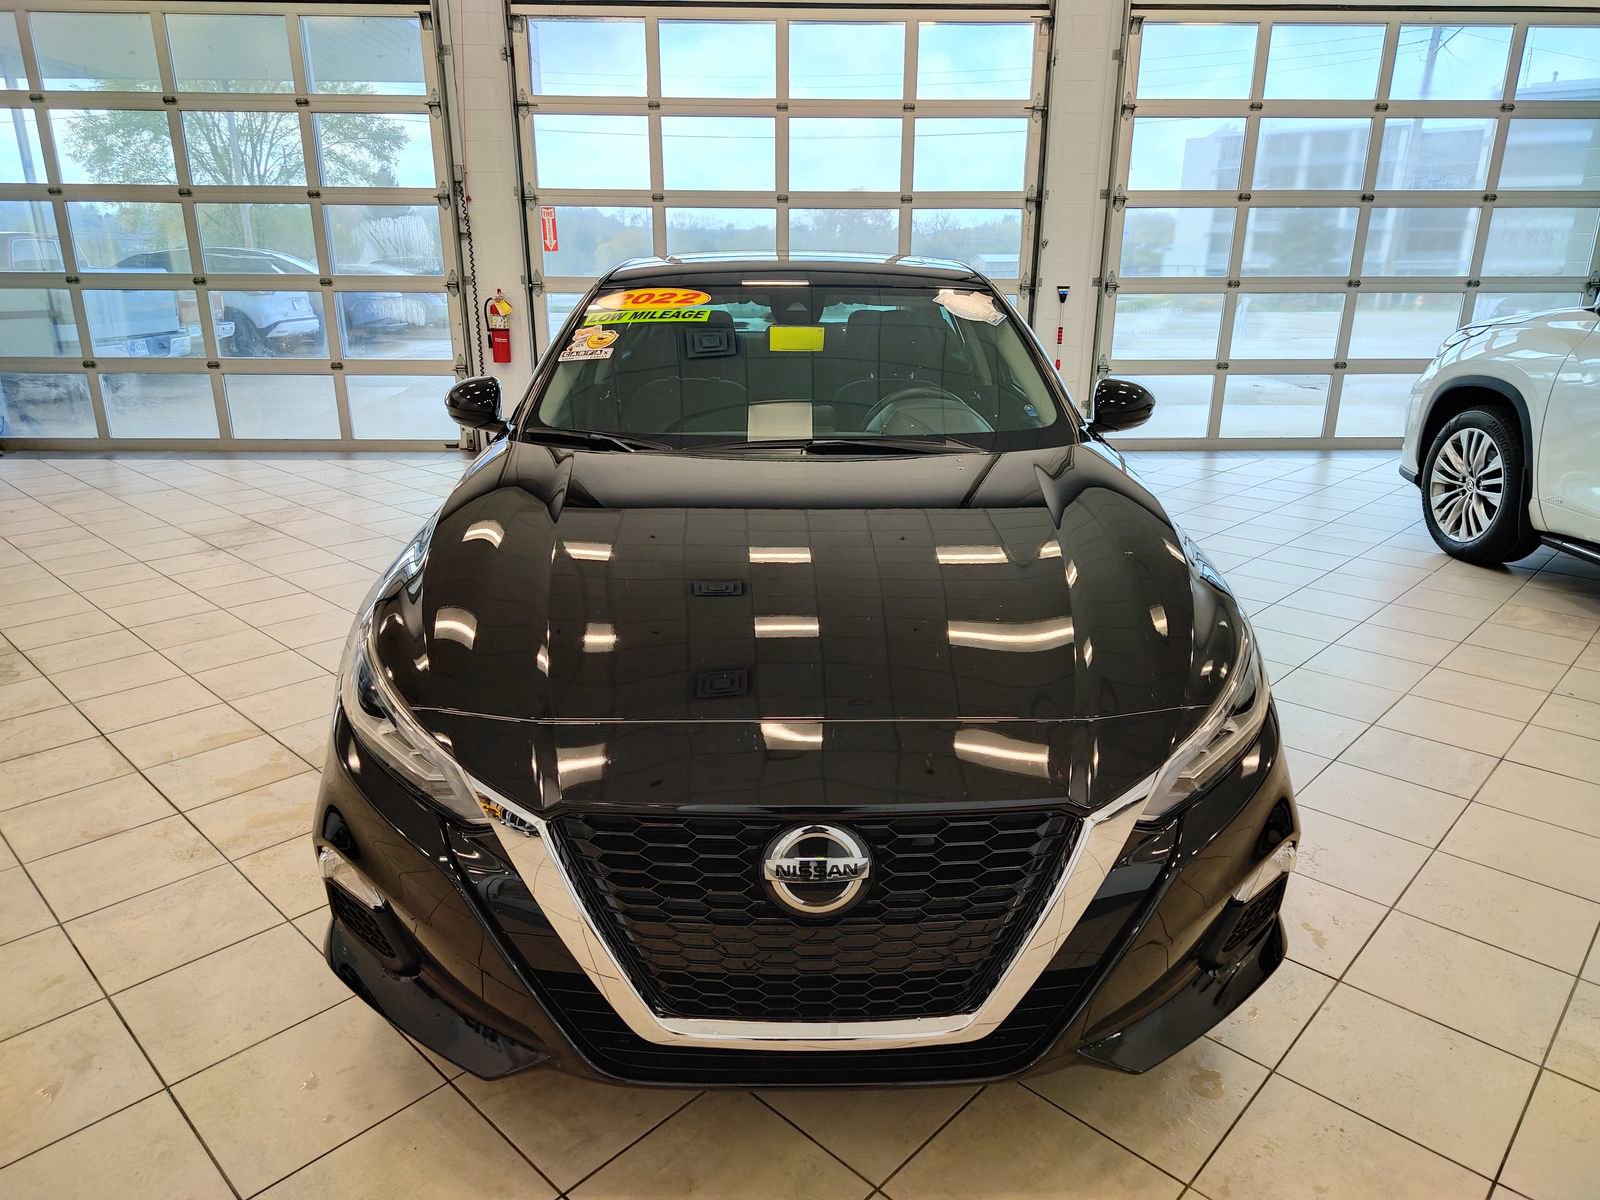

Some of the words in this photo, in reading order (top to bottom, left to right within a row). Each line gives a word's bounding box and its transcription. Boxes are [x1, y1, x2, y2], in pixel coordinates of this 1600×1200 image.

[588, 312, 629, 323] LOW
[628, 310, 708, 321] MILEAGE
[561, 349, 609, 358] CARFAX
[775, 863, 858, 878] NISSAN
